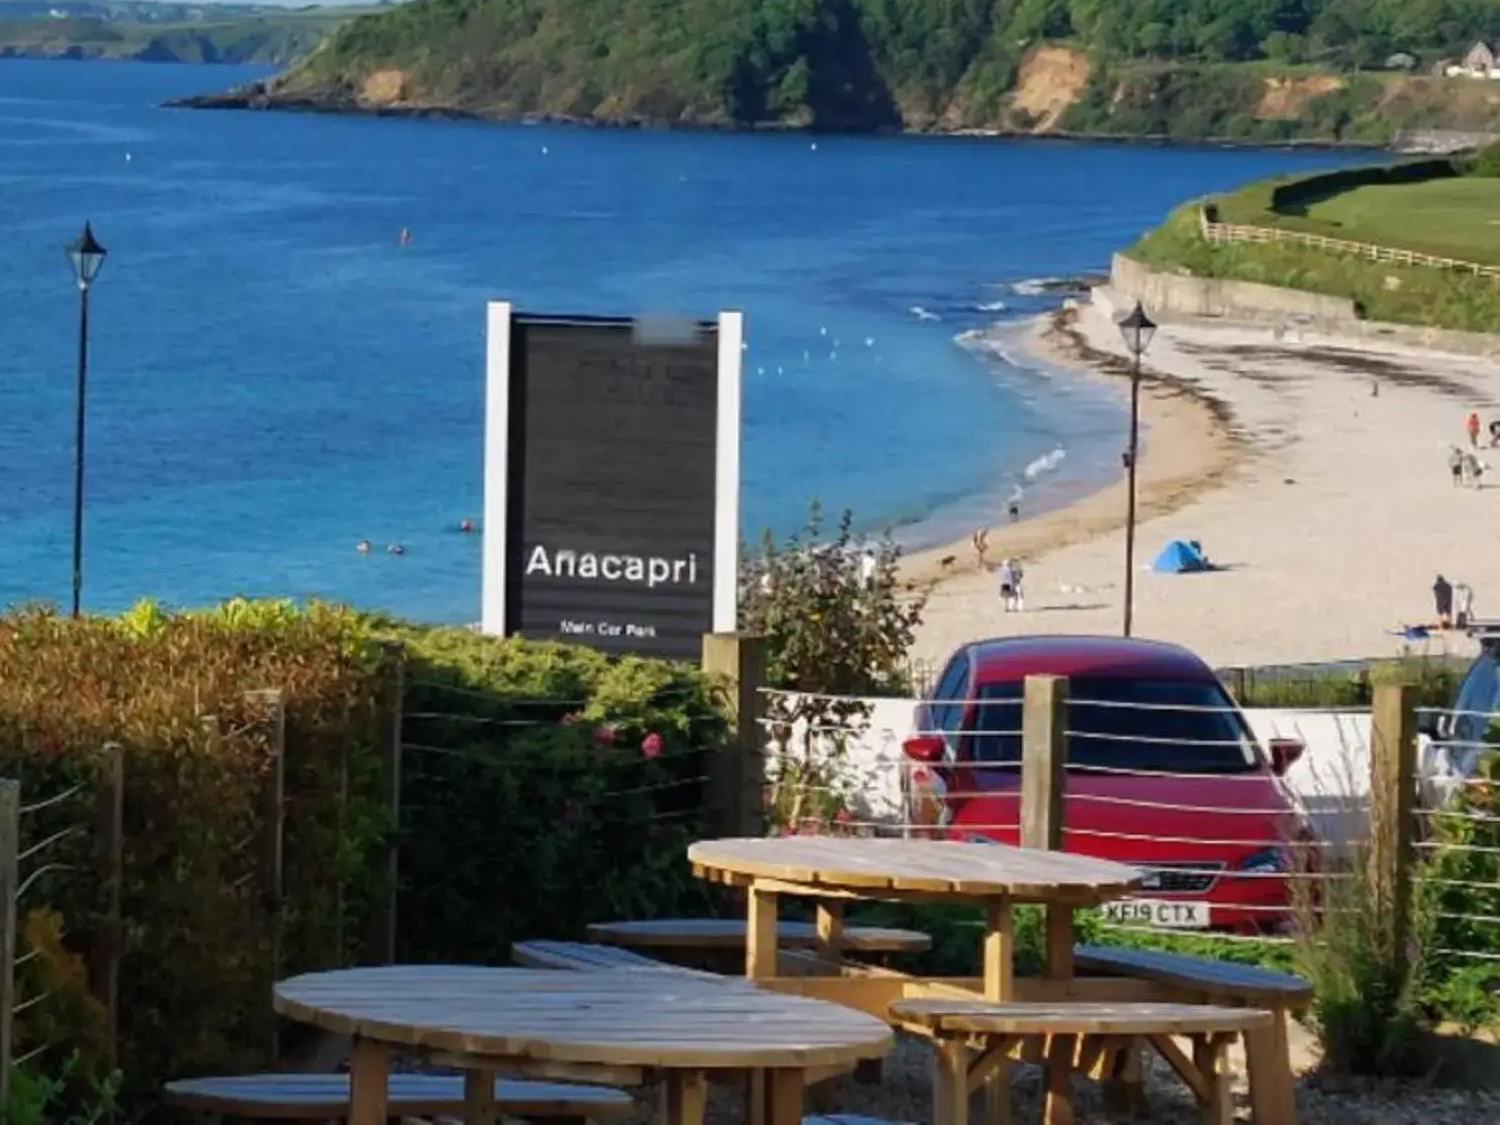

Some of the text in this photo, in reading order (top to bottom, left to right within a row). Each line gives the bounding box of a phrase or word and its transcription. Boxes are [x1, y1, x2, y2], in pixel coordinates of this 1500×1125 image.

[526, 544, 697, 587] Anacapri
[560, 619, 595, 635] Main
[598, 621, 622, 636] Car
[1157, 903, 1197, 923] CTX
